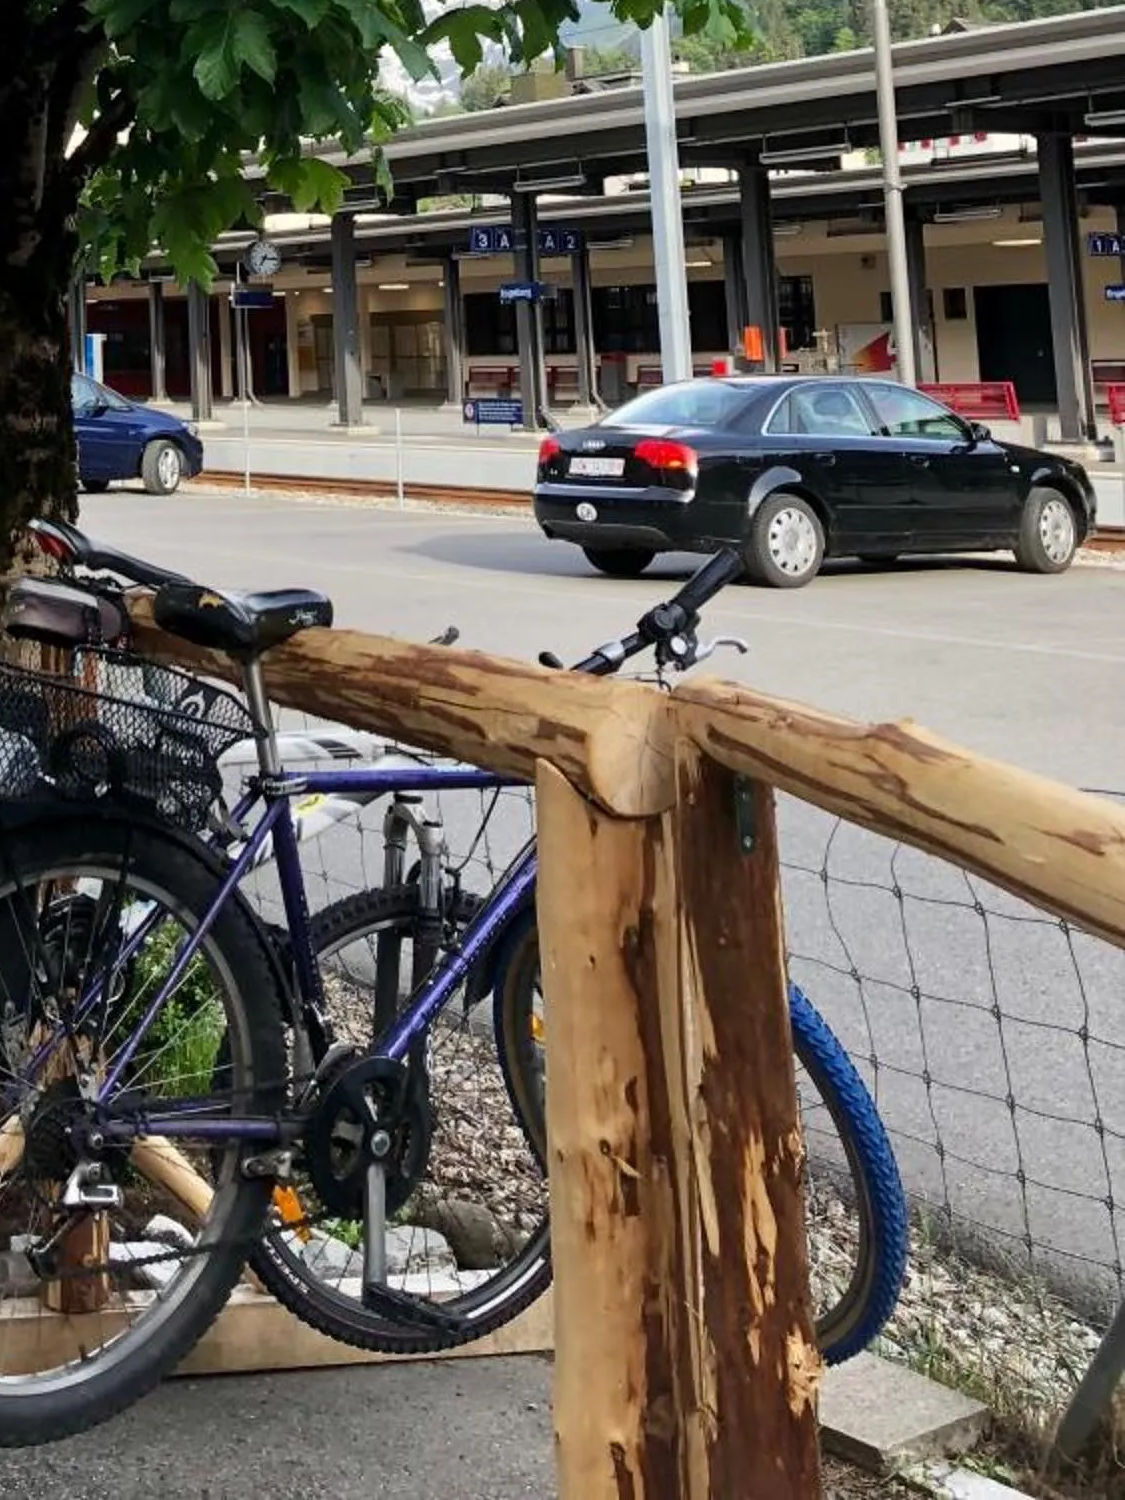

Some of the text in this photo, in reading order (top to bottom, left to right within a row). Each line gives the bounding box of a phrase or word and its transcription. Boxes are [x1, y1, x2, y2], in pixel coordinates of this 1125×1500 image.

[478, 233, 510, 249] 3 A
[544, 234, 576, 249] A 2
